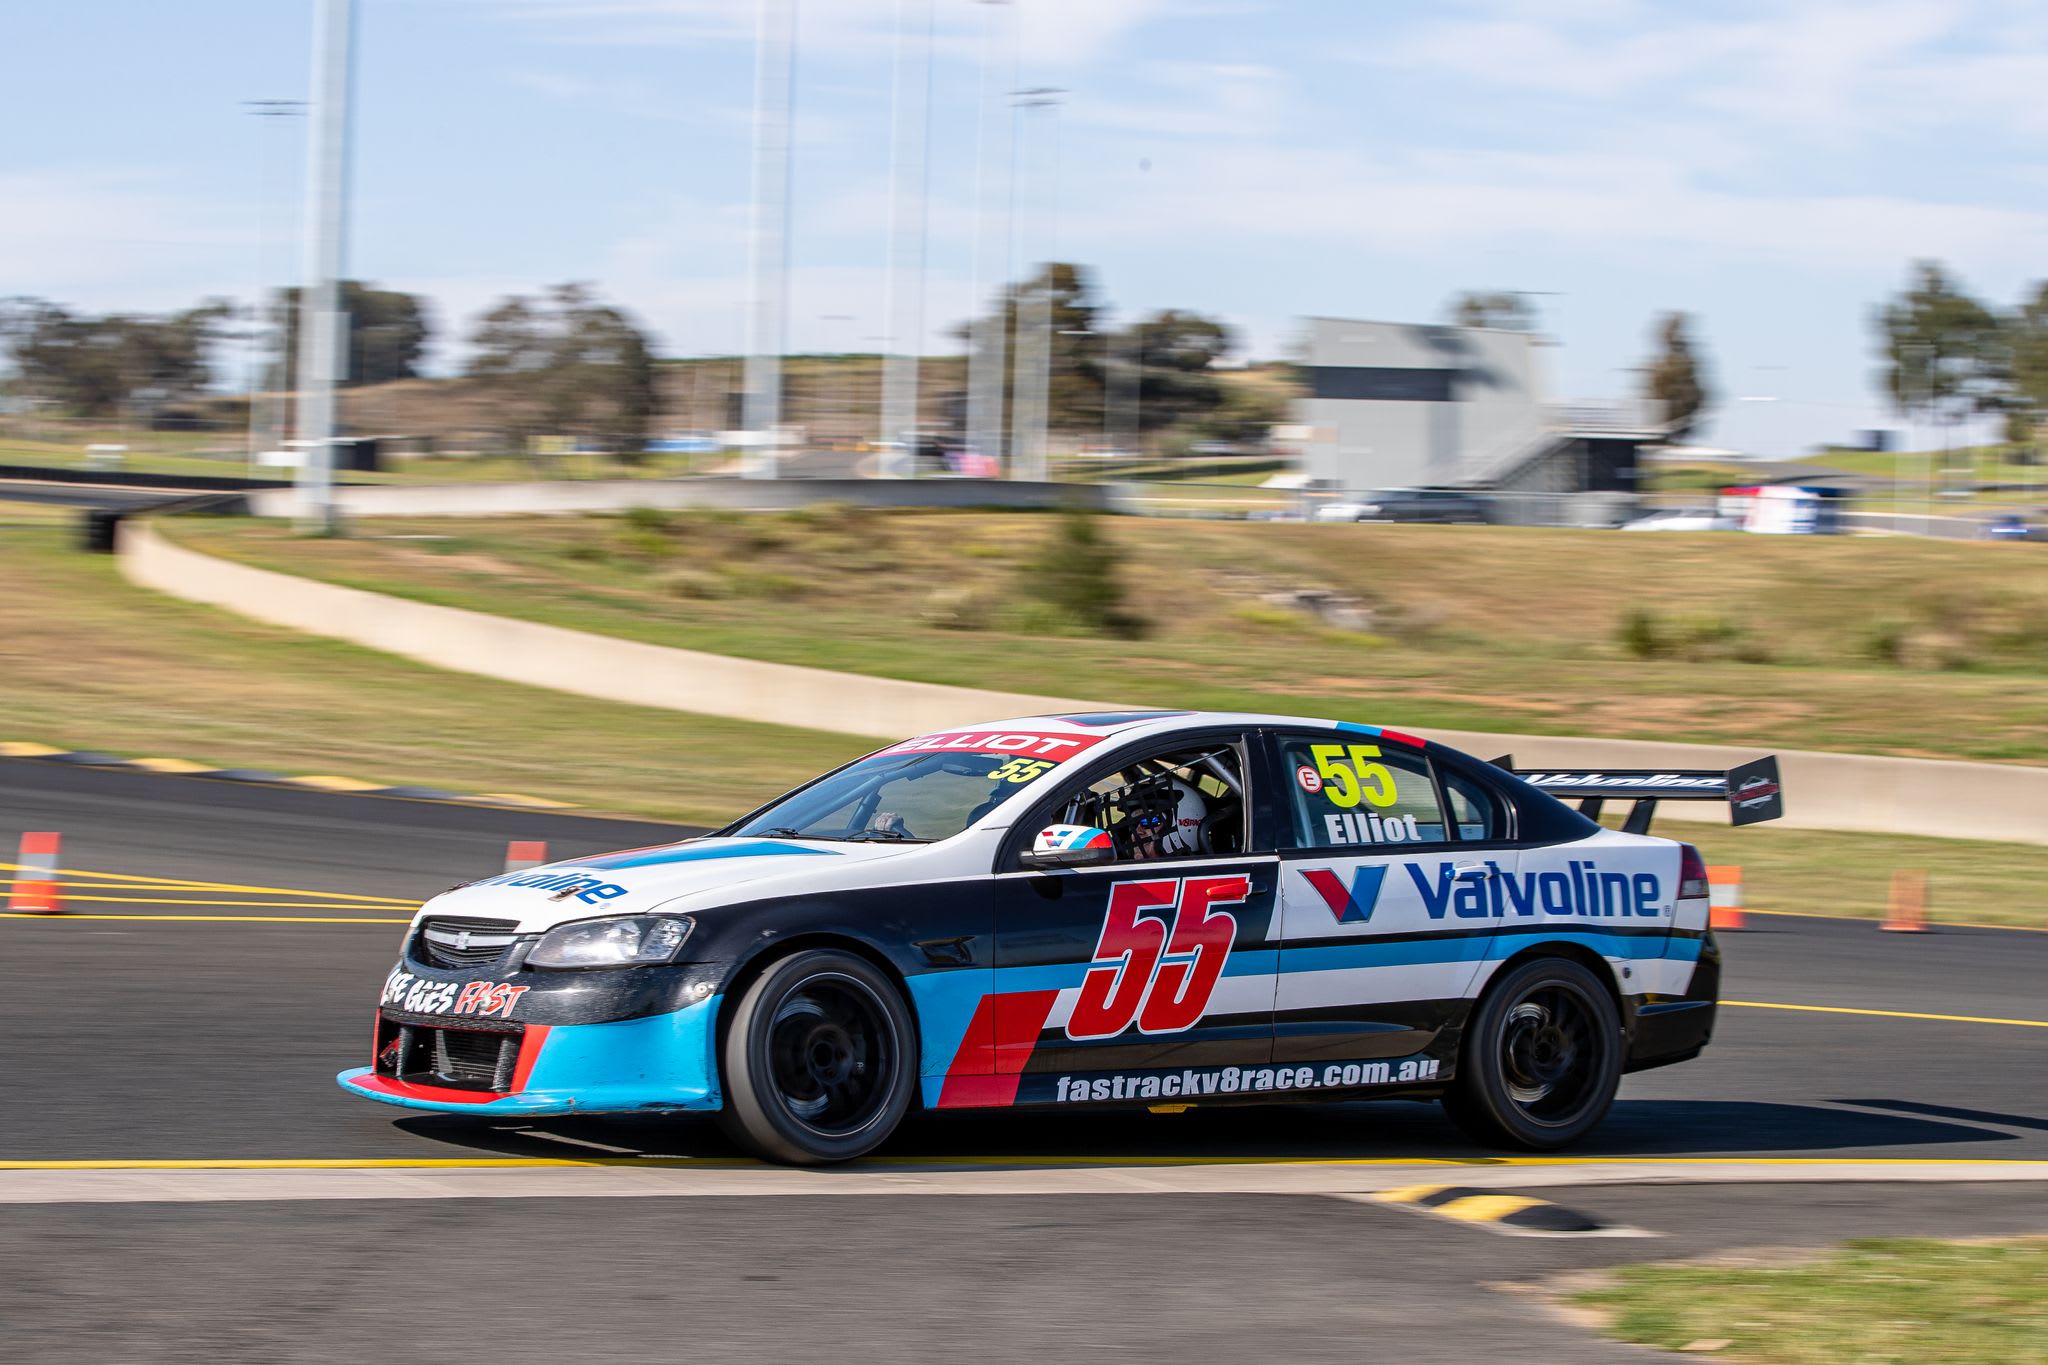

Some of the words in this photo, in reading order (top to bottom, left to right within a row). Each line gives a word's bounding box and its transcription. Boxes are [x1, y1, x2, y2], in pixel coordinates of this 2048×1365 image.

[891, 733, 1081, 754] ELLIOT
[987, 758, 1055, 783] 55
[1302, 771, 1317, 787] E
[1311, 744, 1398, 808] 55
[1323, 812, 1423, 845] Elliot
[1403, 860, 1661, 920] Valvoline
[1065, 873, 1253, 1042] 55
[404, 979, 460, 1014] GOES
[453, 980, 531, 1019] FAST
[1056, 1059, 1441, 1103] fastrackv8race.com.au
